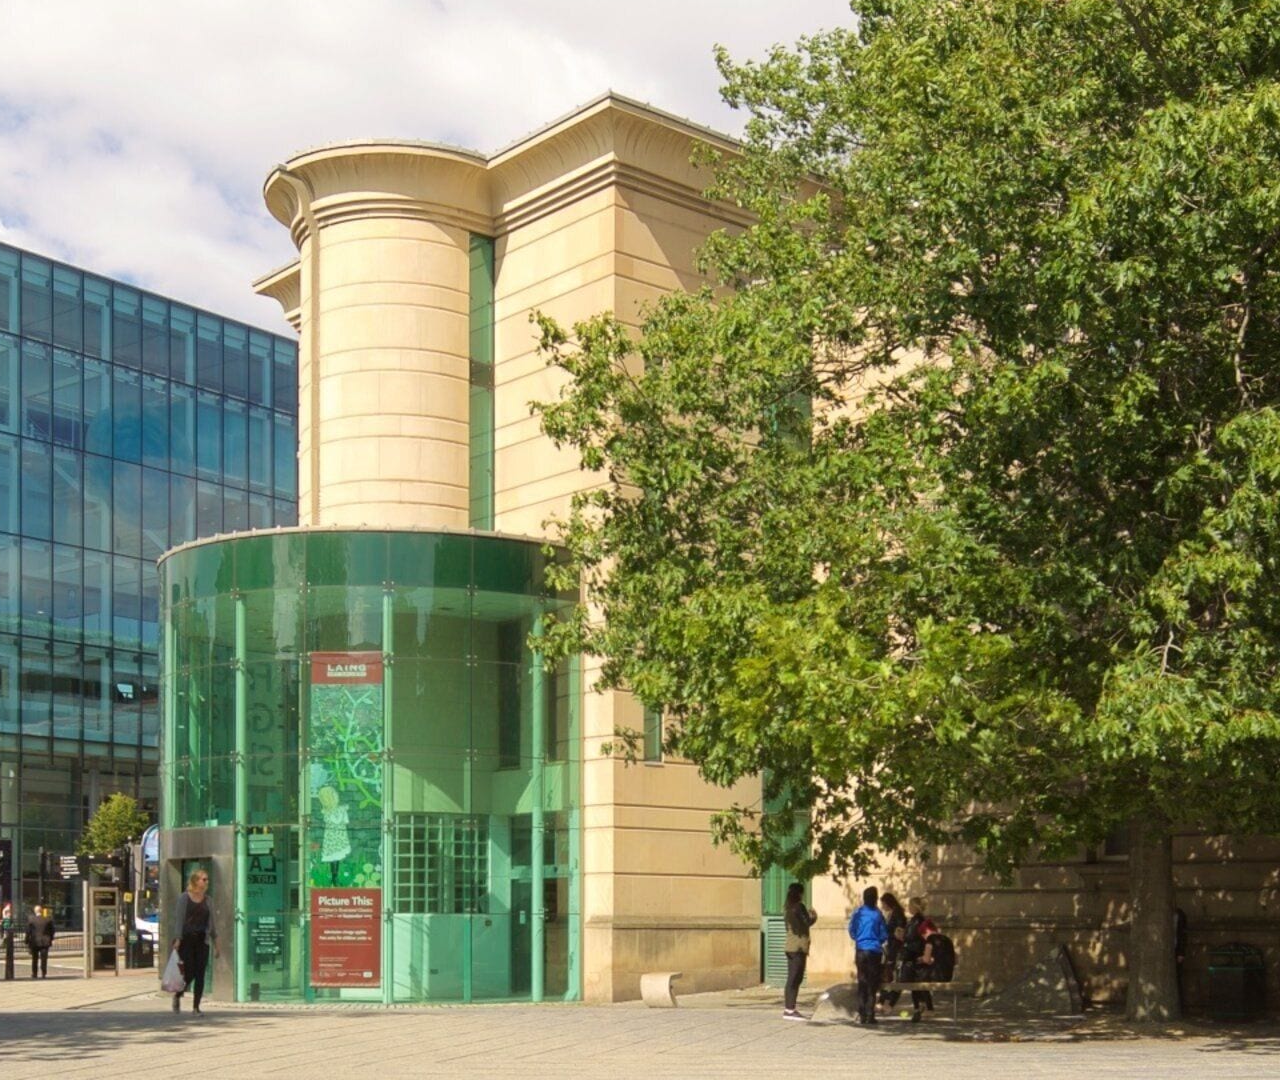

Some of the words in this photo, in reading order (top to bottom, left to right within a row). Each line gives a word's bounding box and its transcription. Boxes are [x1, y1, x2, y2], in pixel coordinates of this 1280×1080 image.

[327, 663, 367, 672] LAING
[318, 896, 350, 906] Picture
[351, 896, 374, 906] This:
